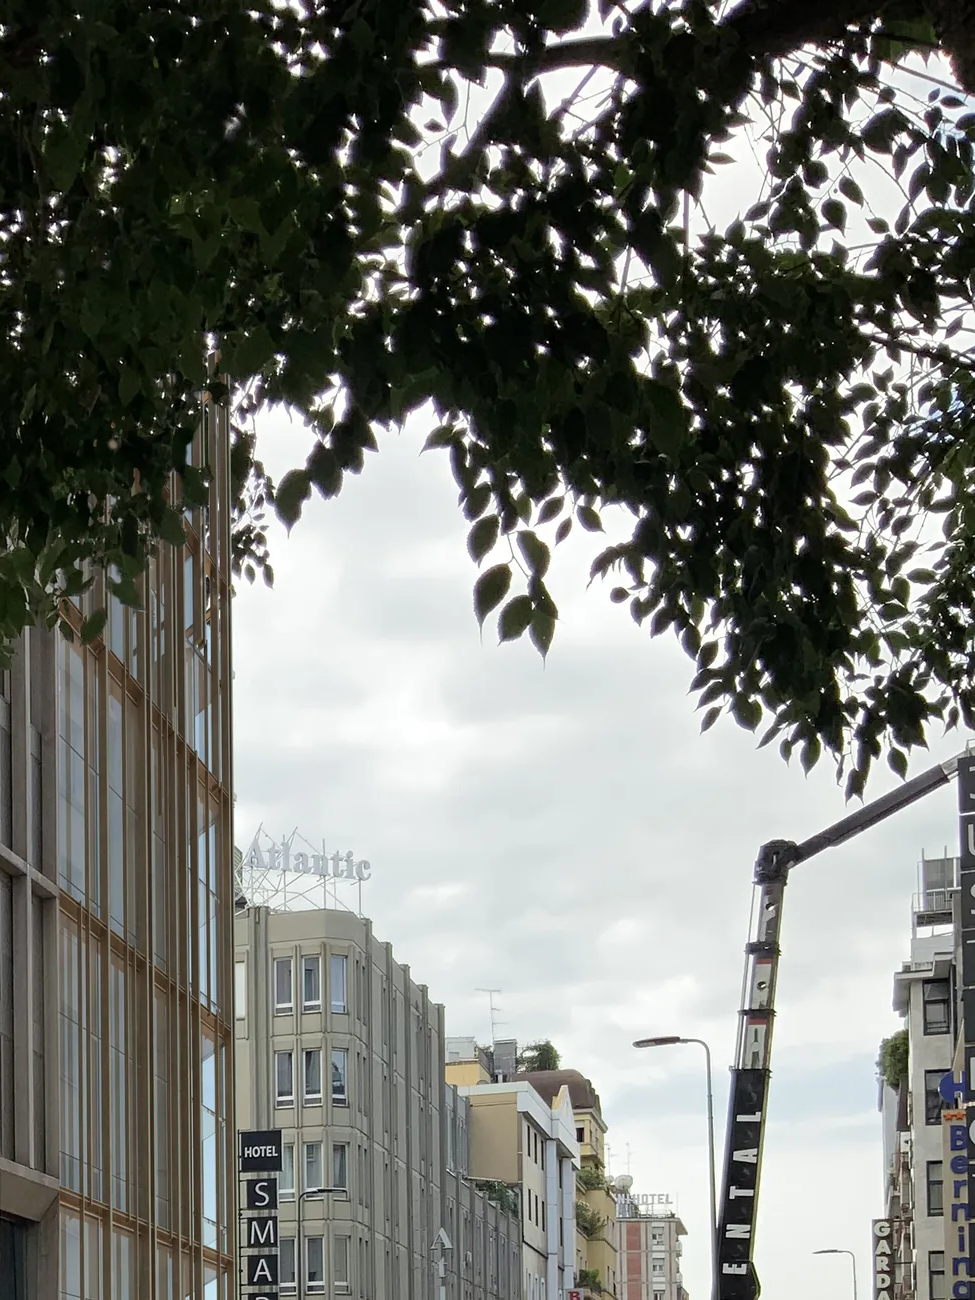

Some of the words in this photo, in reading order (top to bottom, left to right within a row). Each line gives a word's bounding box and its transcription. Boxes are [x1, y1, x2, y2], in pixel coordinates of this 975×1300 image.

[244, 838, 372, 881] Atlantic
[244, 1146, 279, 1158] HOTEL
[633, 1193, 673, 1204] HOTEL
[949, 1125, 971, 1299] Bernina
